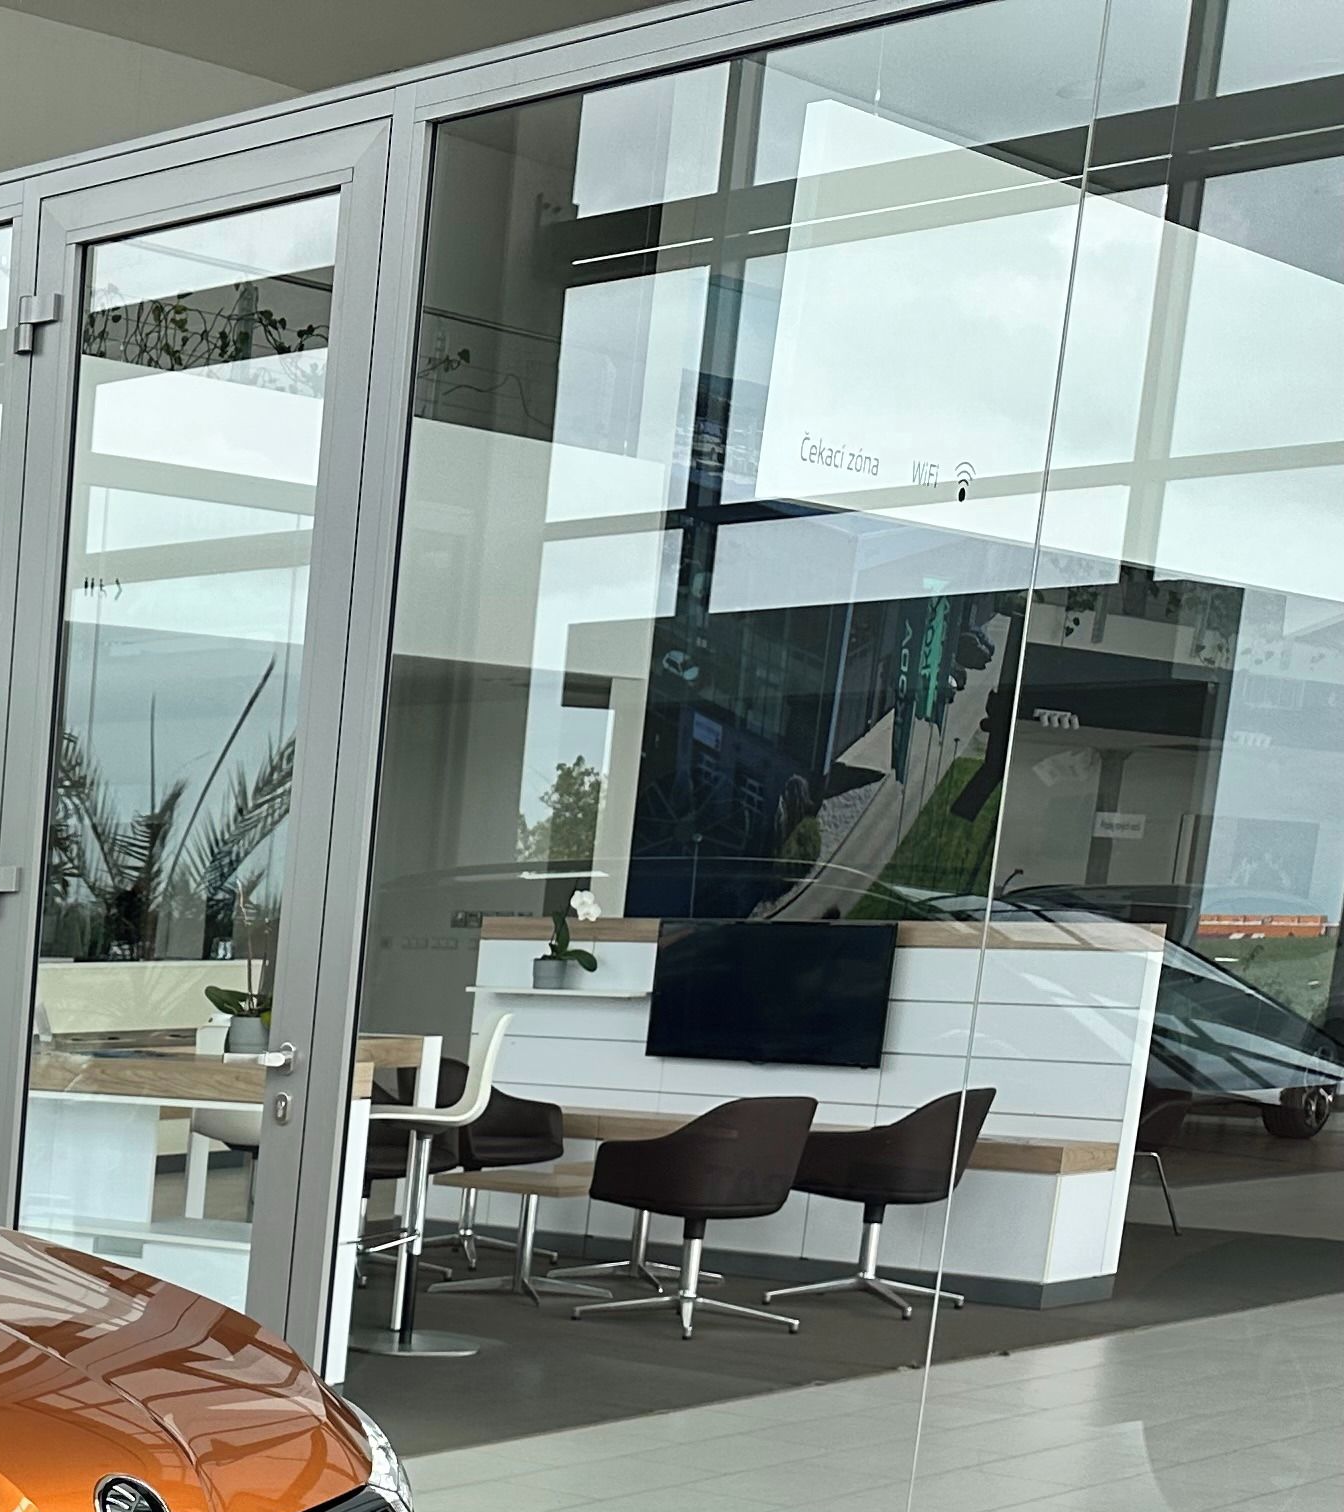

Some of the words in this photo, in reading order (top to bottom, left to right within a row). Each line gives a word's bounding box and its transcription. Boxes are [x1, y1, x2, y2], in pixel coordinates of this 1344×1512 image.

[800, 431, 846, 469] Čekací
[848, 448, 880, 476] zóna
[912, 460, 939, 488] WiFi
